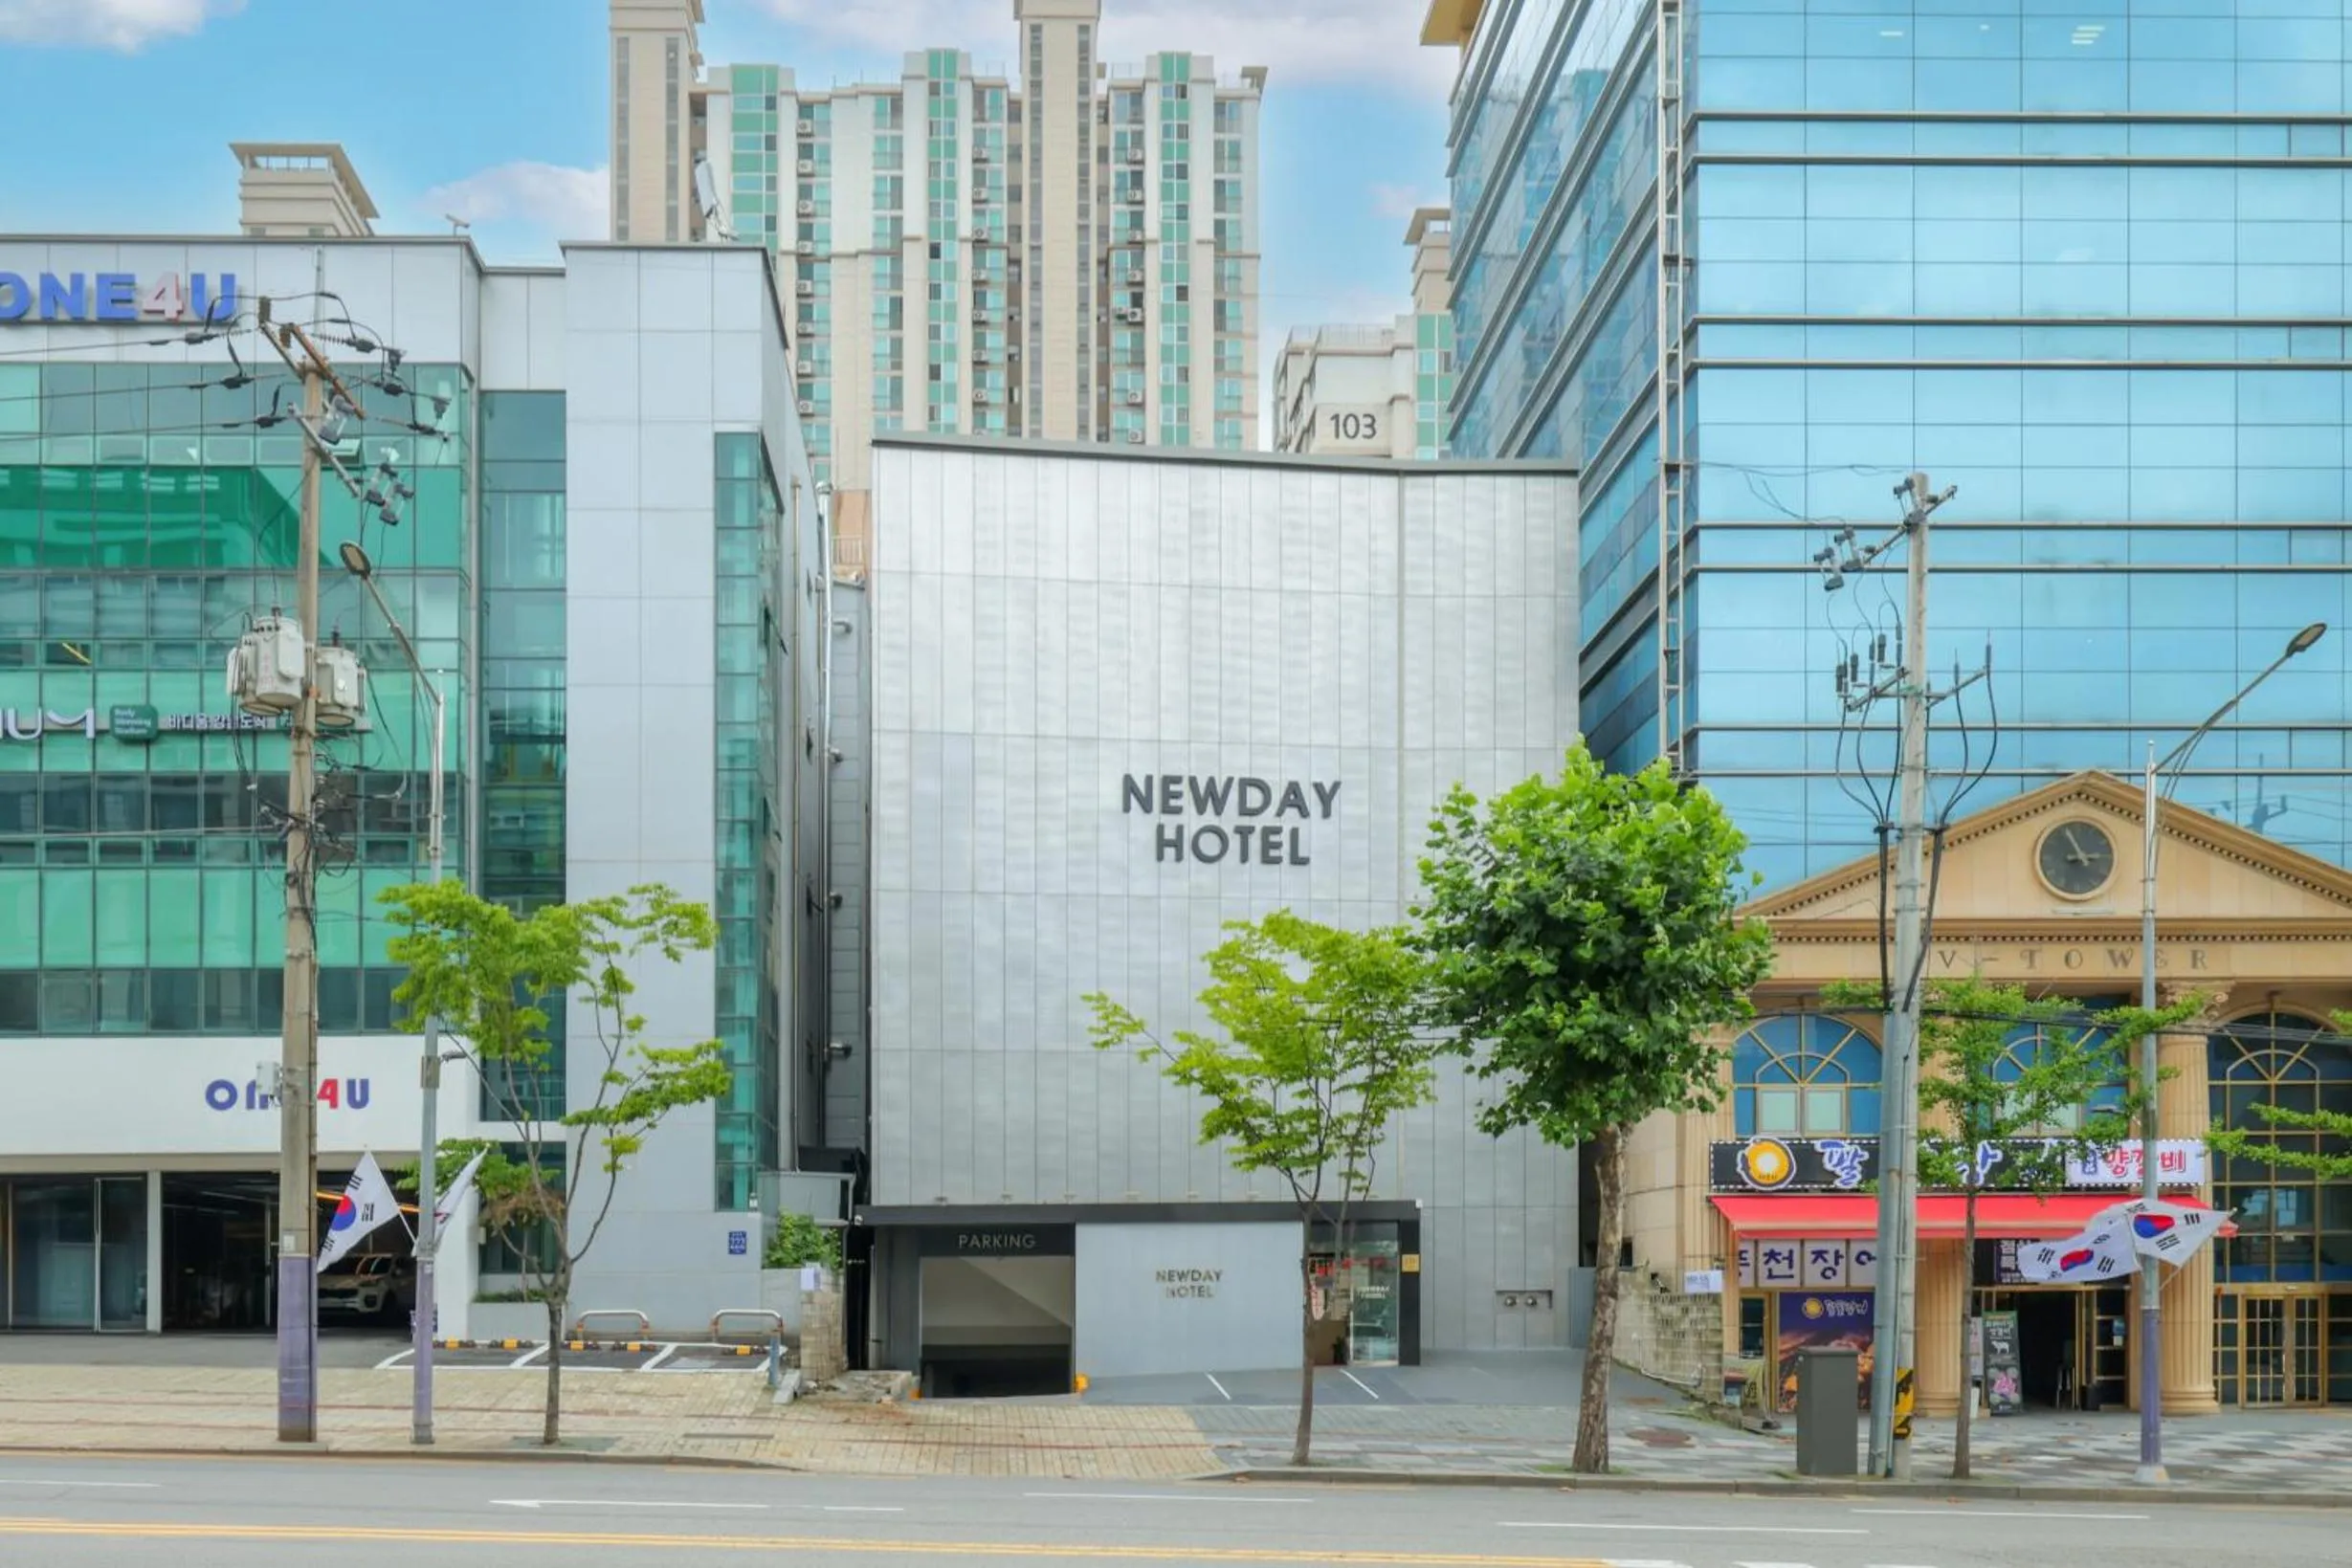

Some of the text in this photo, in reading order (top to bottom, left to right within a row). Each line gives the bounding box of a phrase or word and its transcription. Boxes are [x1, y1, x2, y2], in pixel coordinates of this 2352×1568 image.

[0, 272, 236, 322] ONE4U
[1330, 412, 1376, 439] 103
[1122, 773, 1342, 819] NEWDAY
[1156, 823, 1310, 866] HOTEL
[205, 1078, 369, 1111] O4U
[959, 1234, 1036, 1248] PARKING
[1155, 1269, 1224, 1282] NEWDAY
[1166, 1285, 1214, 1298] HOTEL
